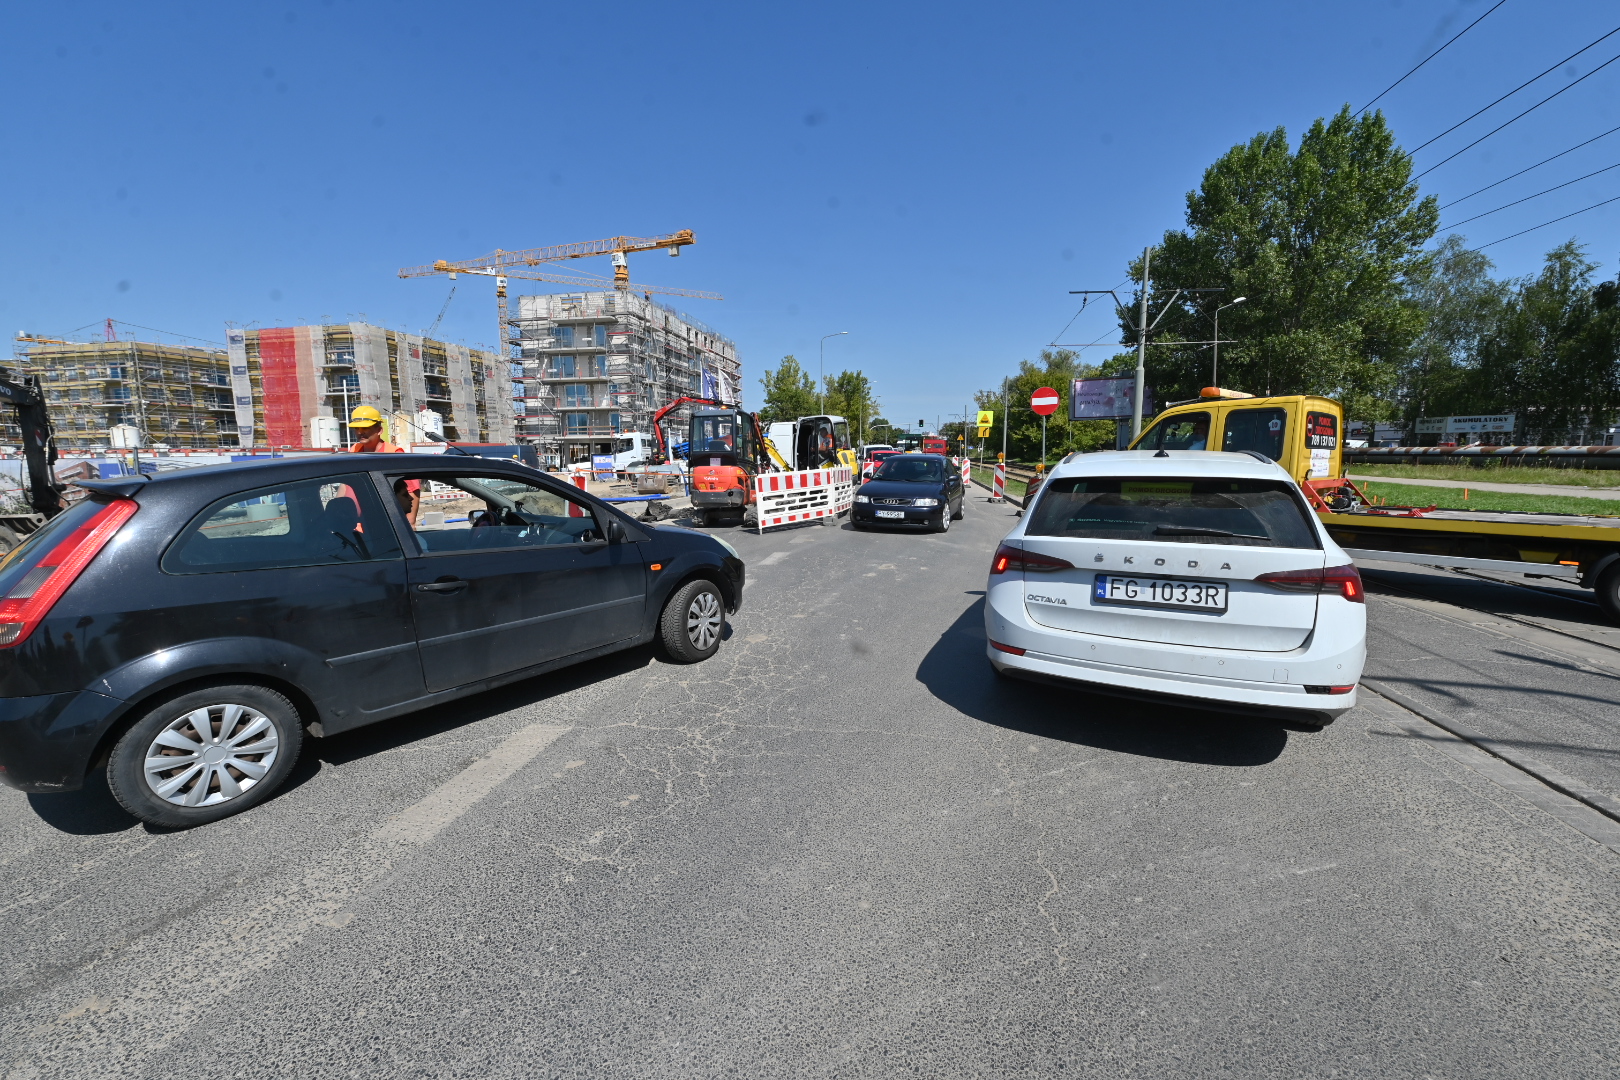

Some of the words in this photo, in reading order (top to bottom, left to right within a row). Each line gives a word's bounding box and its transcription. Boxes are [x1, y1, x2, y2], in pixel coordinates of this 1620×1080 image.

[0, 386, 11, 395] VO
[1312, 435, 1320, 446] 789
[1320, 436, 1328, 447] 137
[1328, 437, 1336, 447] 021
[1094, 553, 1231, 571] ŠKODA
[1097, 588, 1106, 596] PL
[1110, 579, 1139, 599] FG
[1149, 580, 1220, 606] 1033R
[1027, 594, 1068, 606] OCTAVIA
